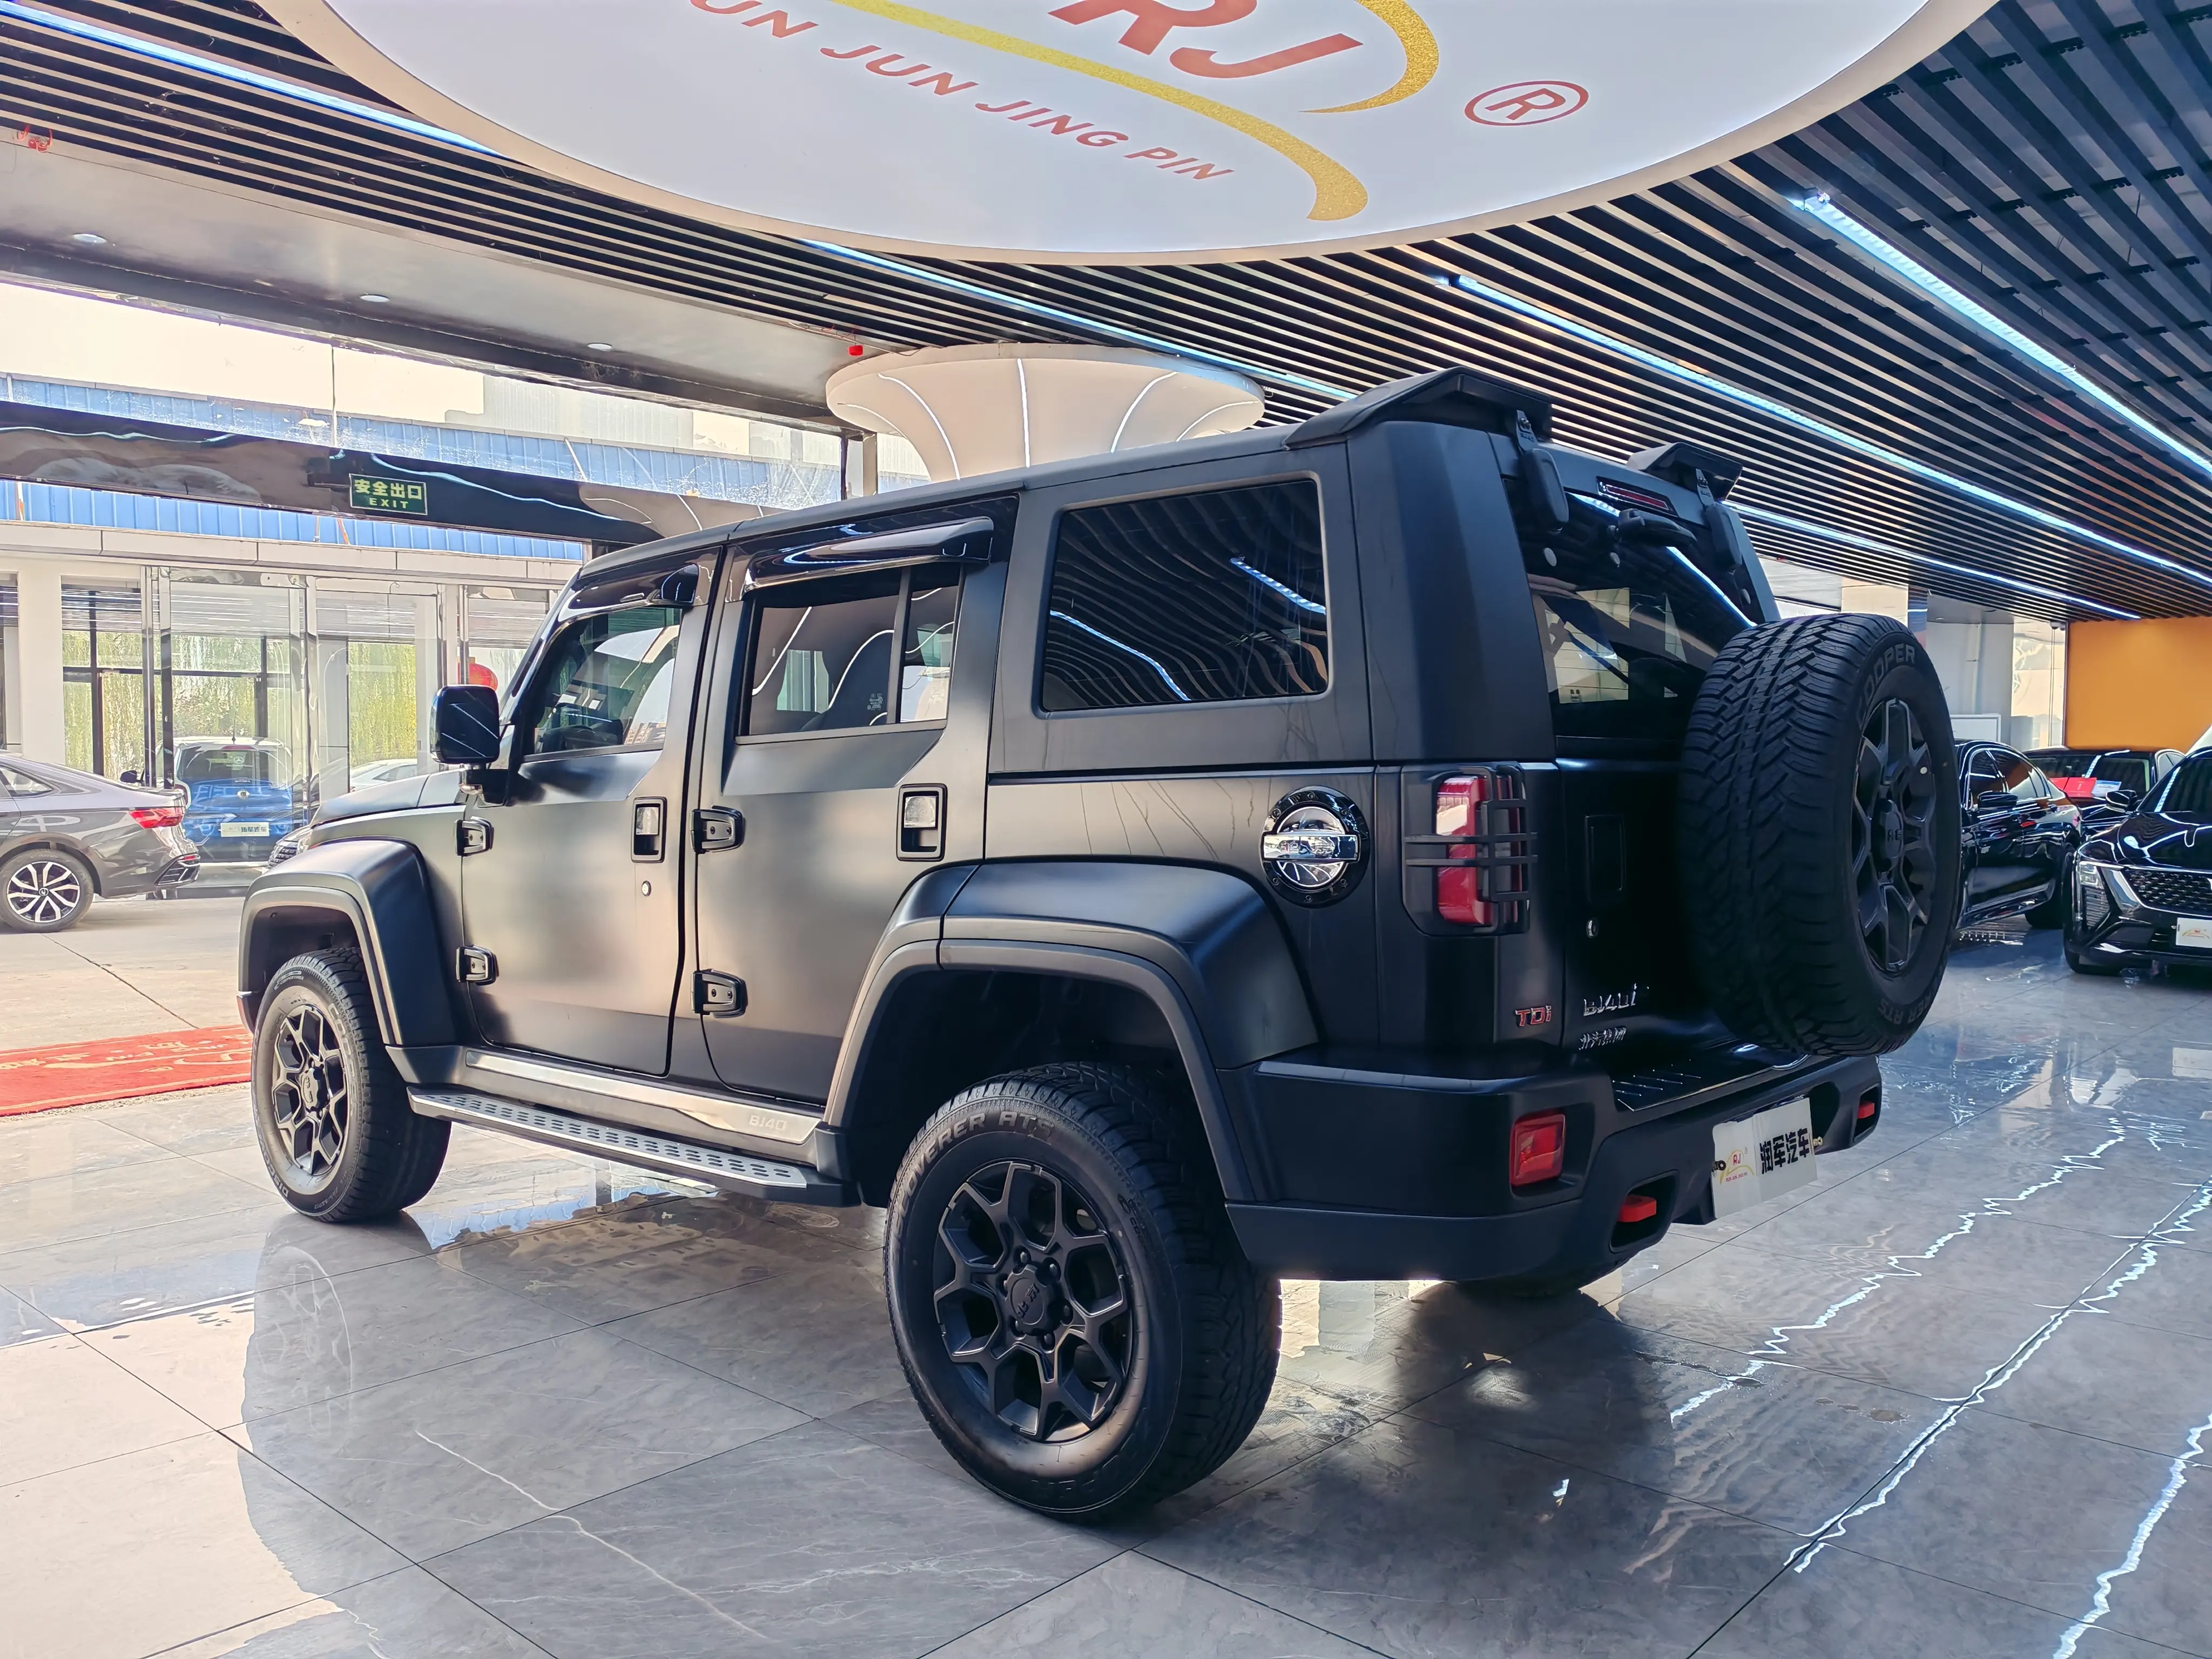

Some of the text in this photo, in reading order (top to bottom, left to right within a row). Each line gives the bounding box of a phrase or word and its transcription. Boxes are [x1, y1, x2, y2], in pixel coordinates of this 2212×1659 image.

[820, 45, 979, 96] JUN
[975, 100, 1129, 147] JING
[1123, 147, 1235, 179] PIN
[354, 479, 422, 500] 安全出口
[369, 497, 408, 509] EXIT
[749, 1115, 787, 1131] BJ40
[1759, 1128, 1810, 1175] 润军汽车
